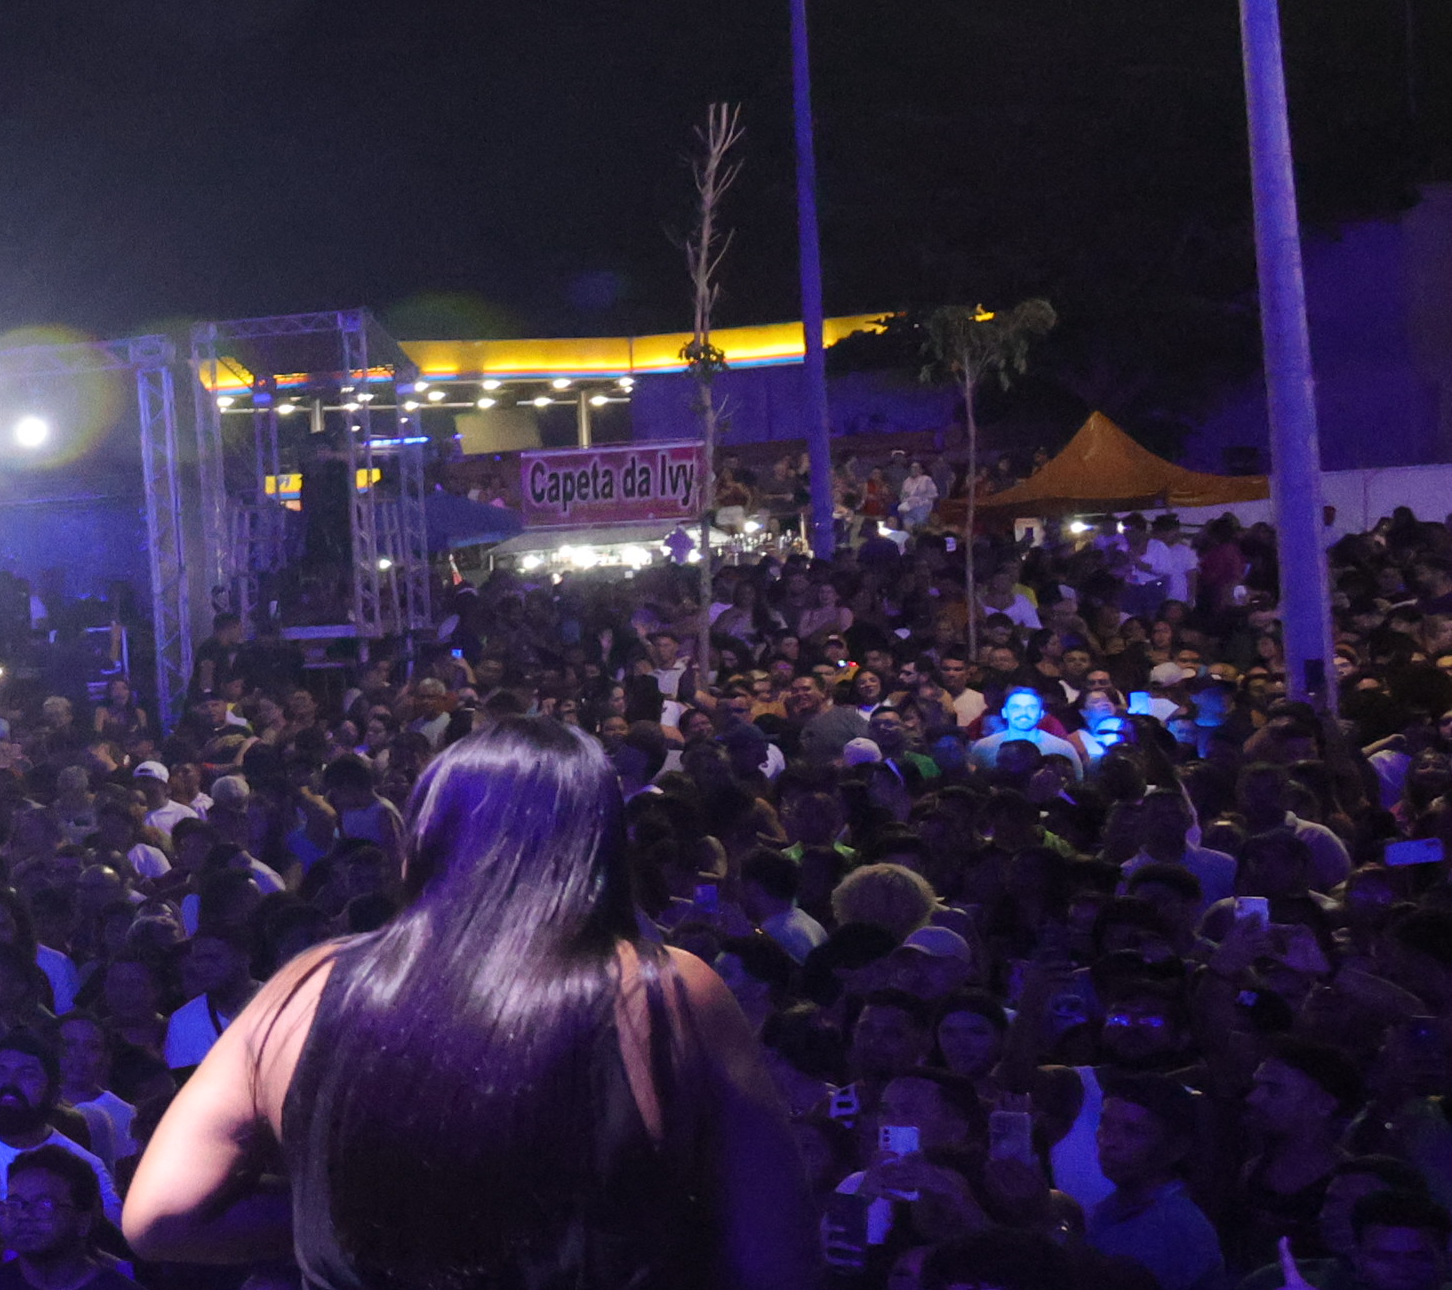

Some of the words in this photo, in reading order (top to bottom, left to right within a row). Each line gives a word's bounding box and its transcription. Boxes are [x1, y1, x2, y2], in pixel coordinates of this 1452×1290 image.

[530, 459, 614, 512] Capeta
[623, 456, 652, 498] da
[659, 454, 695, 507] Ivy
